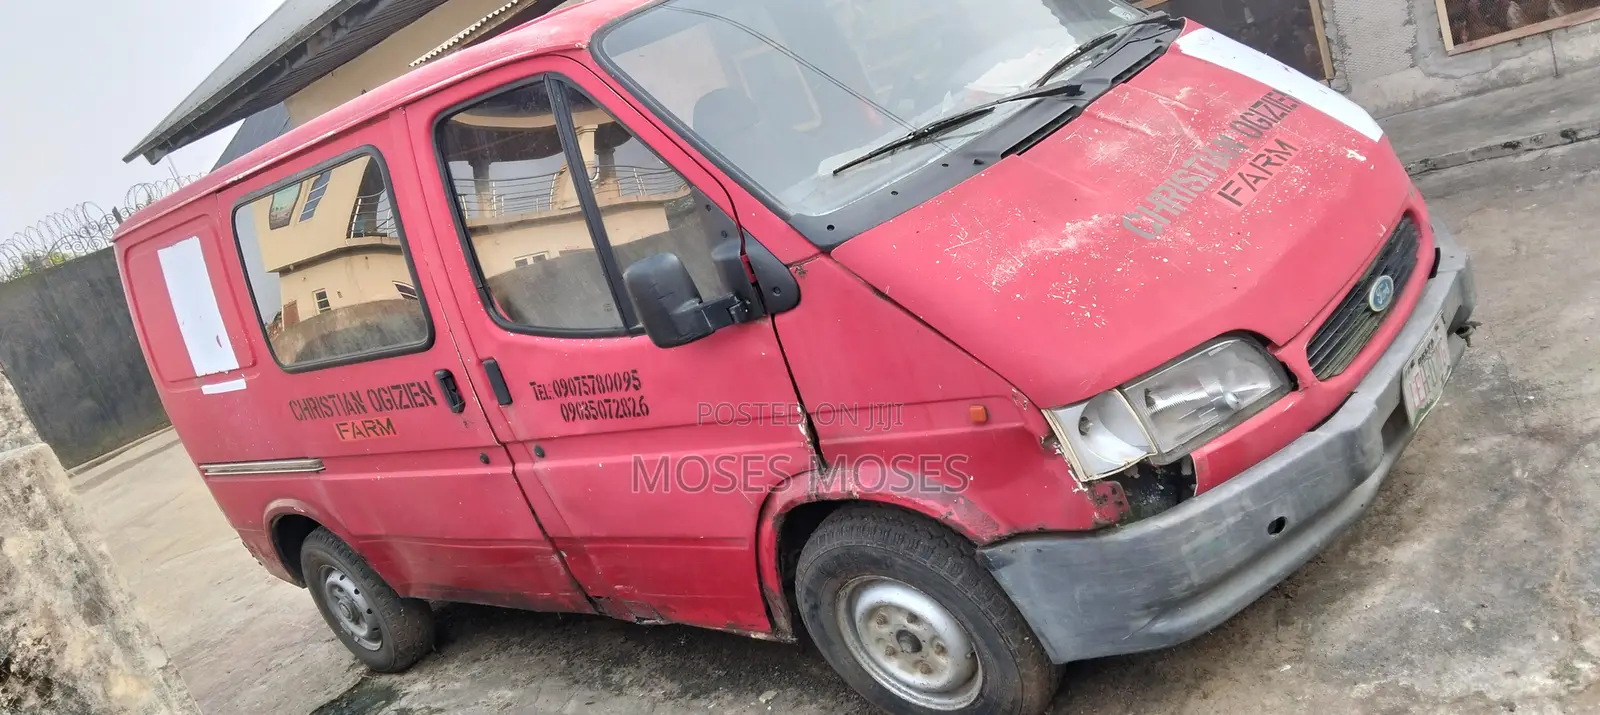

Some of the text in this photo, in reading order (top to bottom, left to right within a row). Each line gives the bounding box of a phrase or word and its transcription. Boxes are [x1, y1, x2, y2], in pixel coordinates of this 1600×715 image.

[1217, 138, 1299, 207] FARM
[289, 381, 437, 421] CHRISTIAN OGIZIEN
[335, 417, 397, 439] FARM
